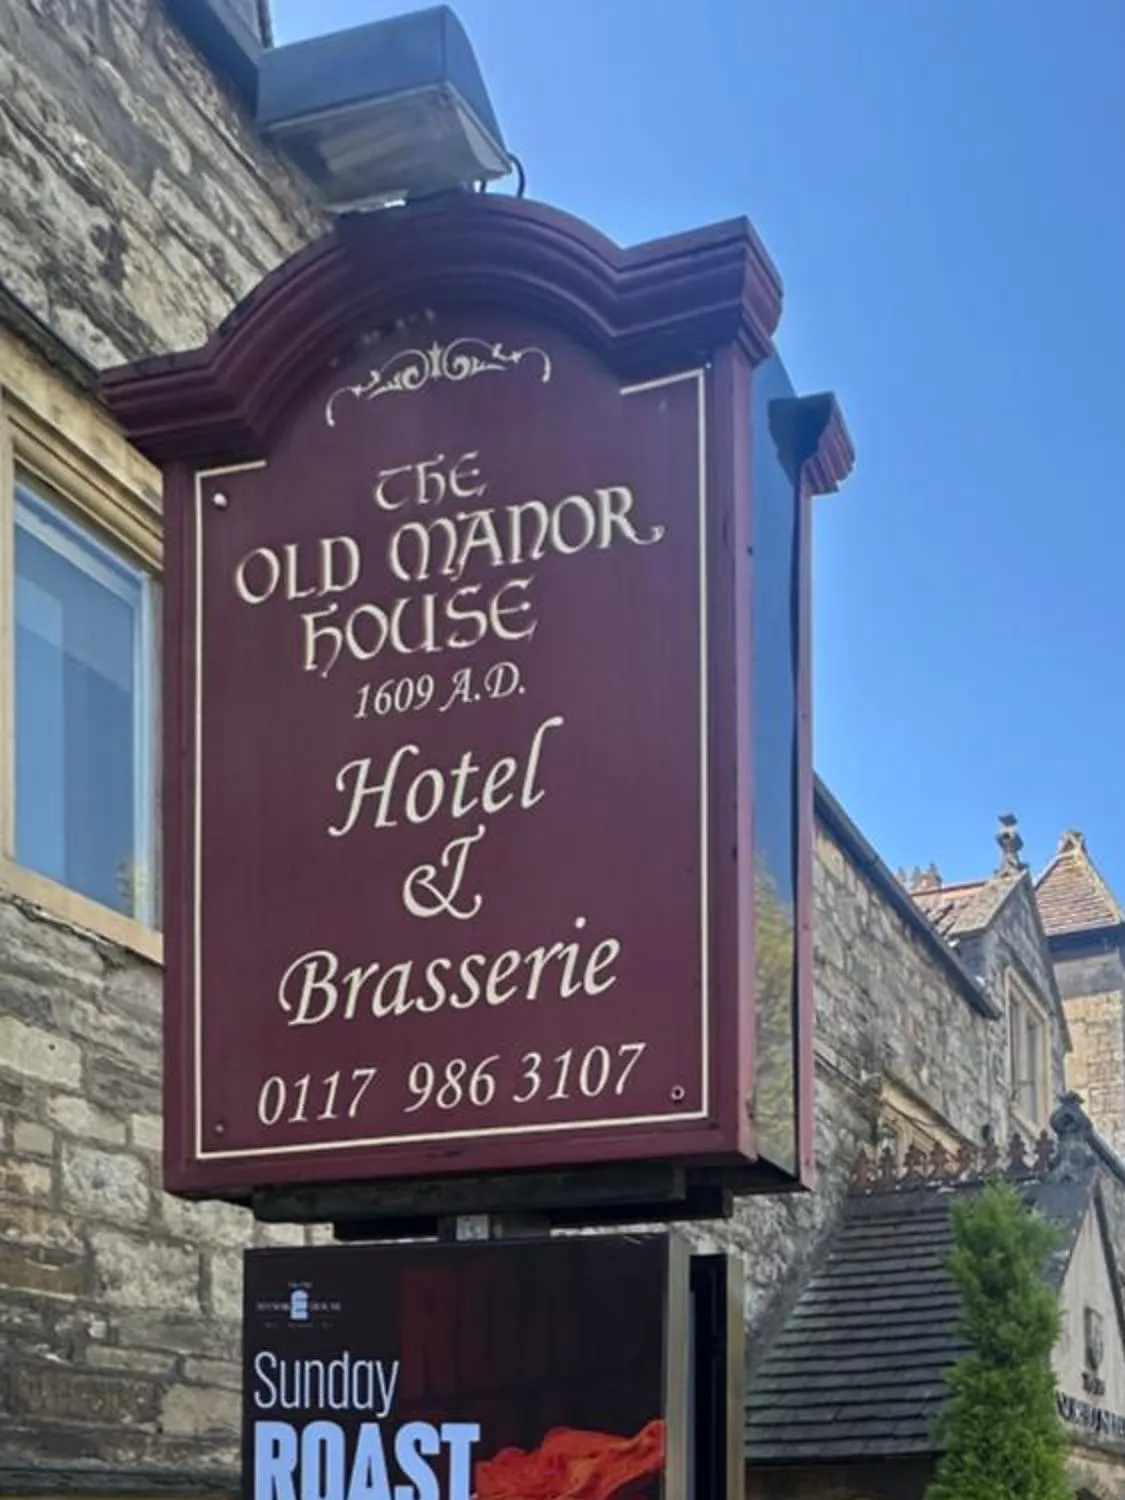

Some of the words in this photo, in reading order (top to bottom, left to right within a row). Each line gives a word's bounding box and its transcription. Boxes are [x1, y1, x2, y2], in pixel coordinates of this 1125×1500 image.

[235, 536, 360, 604] OLD
[389, 486, 665, 583] MANOR
[303, 573, 538, 677] HOUSE
[353, 673, 435, 719] 1609
[440, 661, 525, 713] A.D.
[328, 716, 564, 837] Hotel
[402, 825, 485, 919] &
[278, 916, 620, 1026] Brasserie
[257, 1068, 376, 1127] 0117
[404, 1055, 500, 1113] 986
[513, 1042, 645, 1103] 3107
[254, 1351, 399, 1418] Sunday
